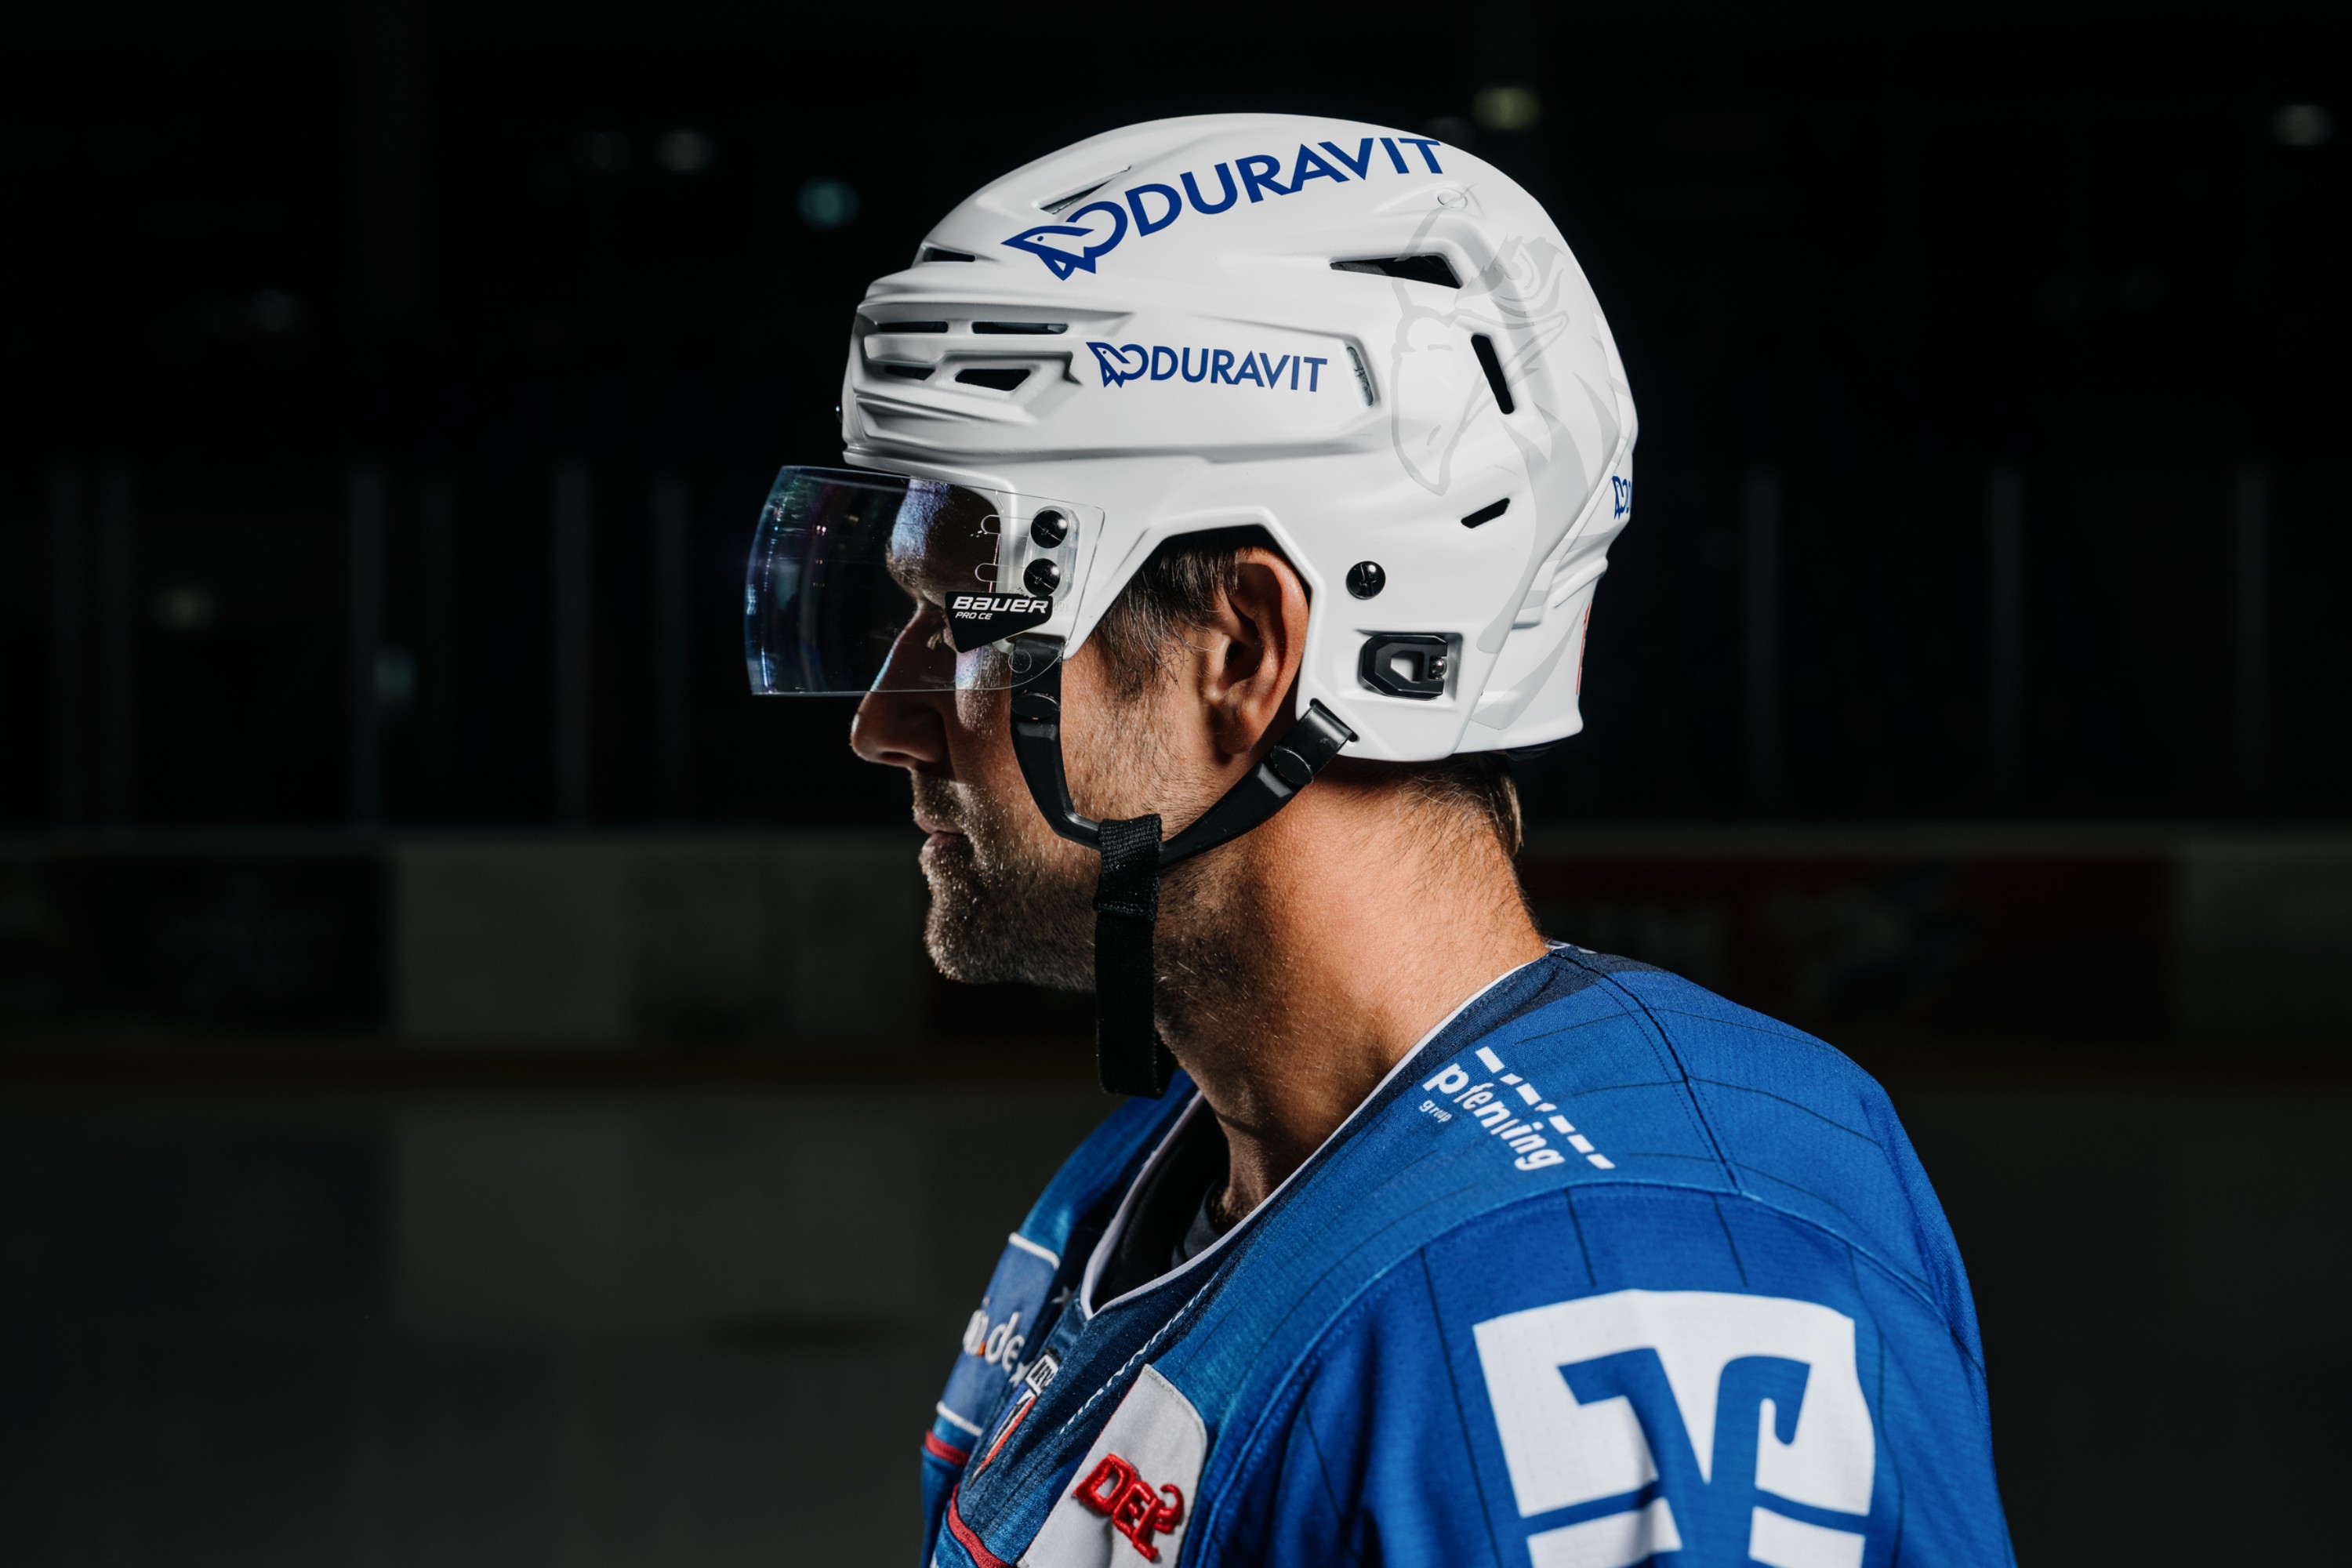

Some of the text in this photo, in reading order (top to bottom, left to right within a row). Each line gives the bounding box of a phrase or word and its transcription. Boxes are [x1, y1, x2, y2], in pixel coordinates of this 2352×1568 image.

[1124, 136, 1442, 238] DURAVIT
[1150, 345, 1328, 393] DURAVIT
[1419, 1099, 1452, 1123] group
